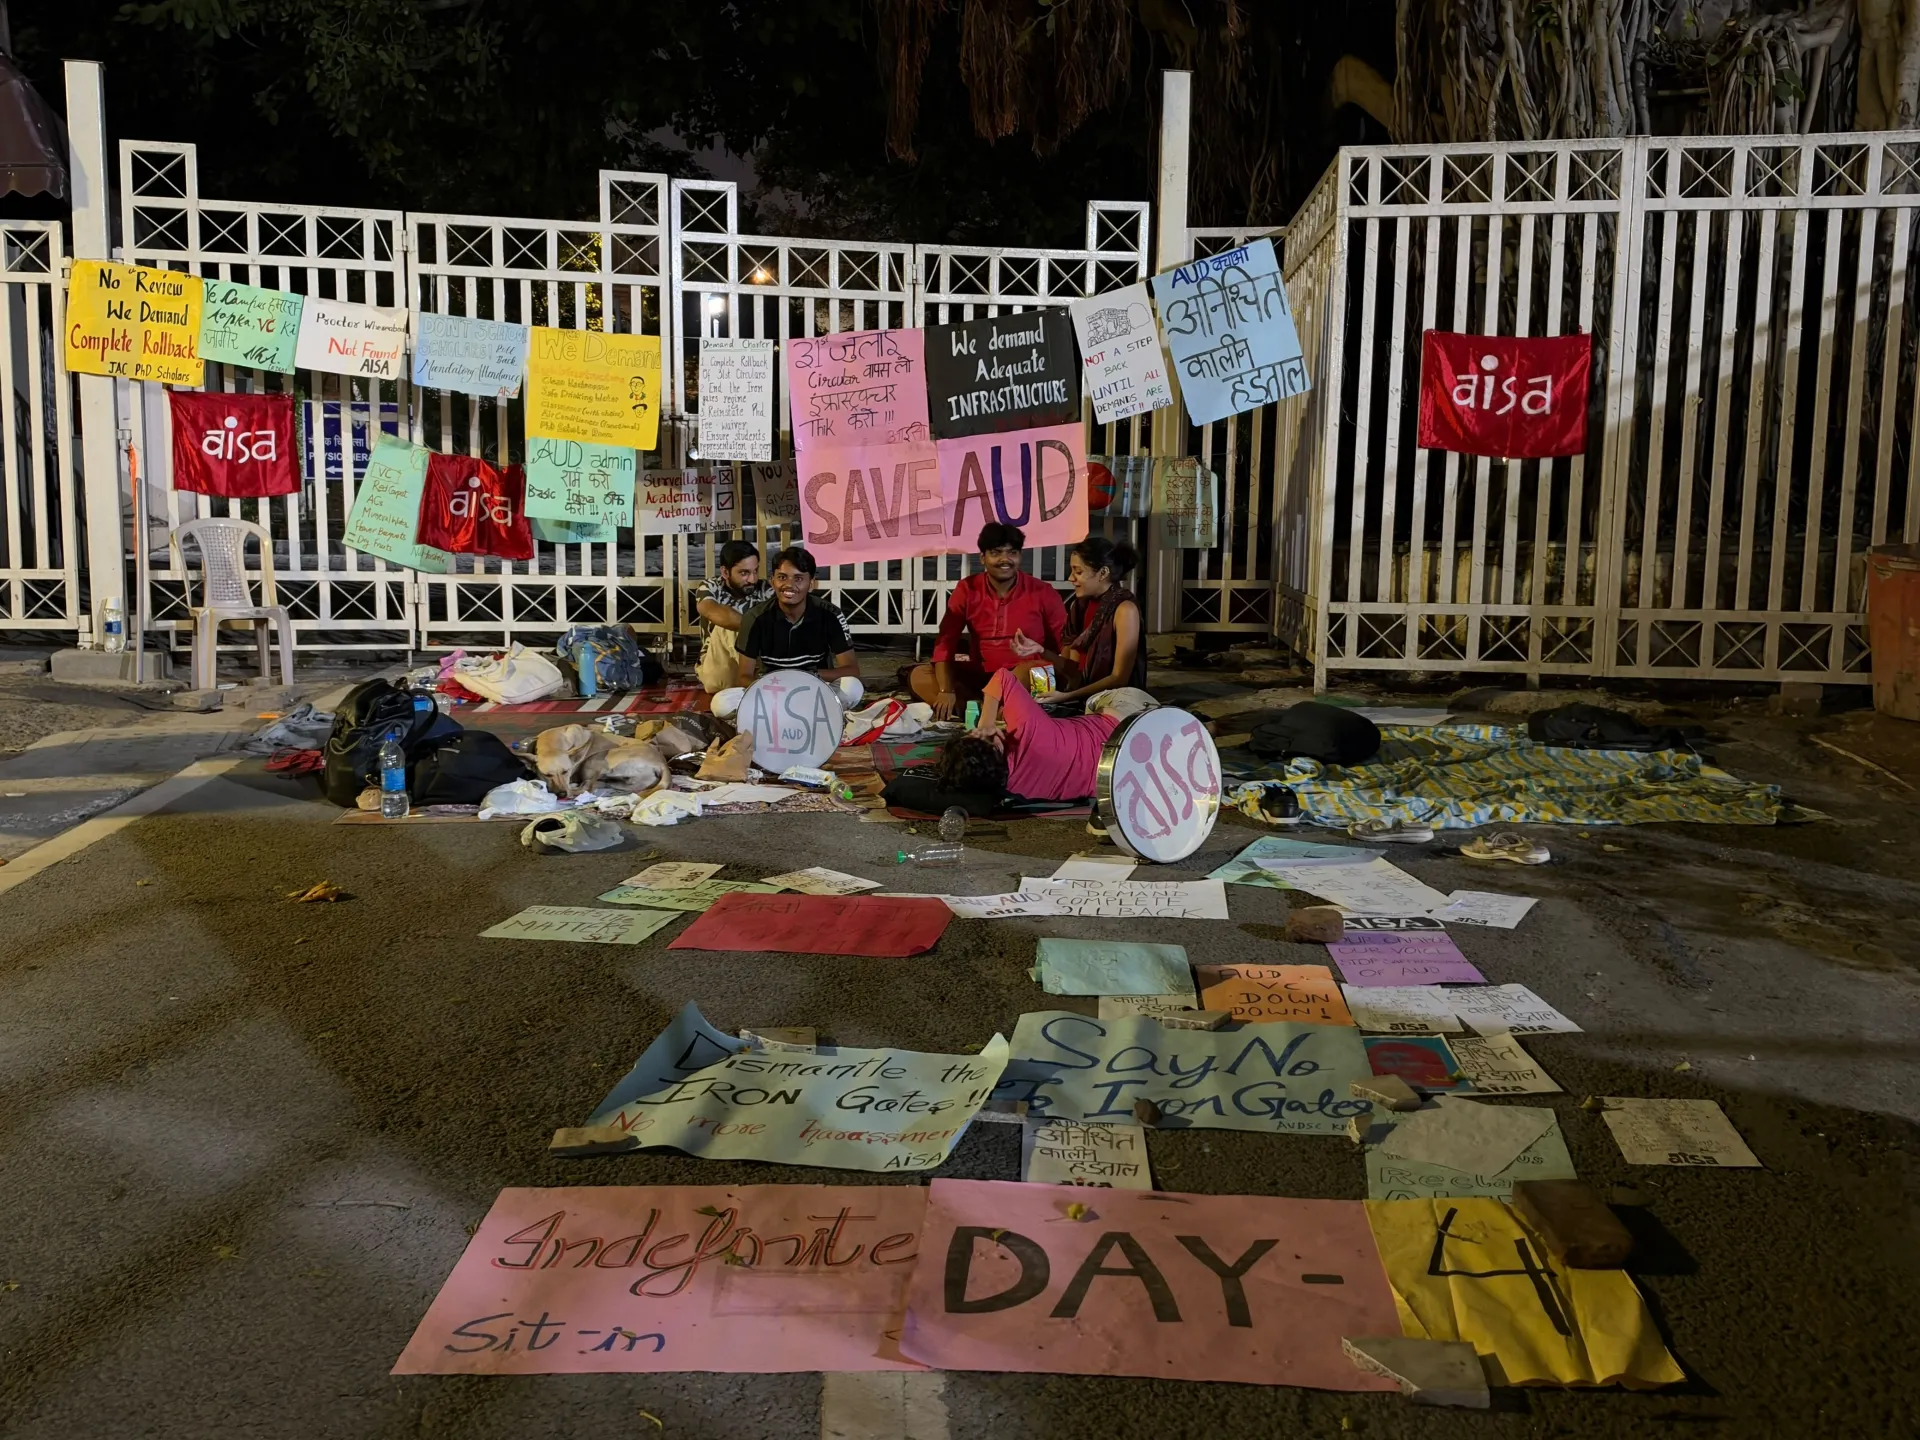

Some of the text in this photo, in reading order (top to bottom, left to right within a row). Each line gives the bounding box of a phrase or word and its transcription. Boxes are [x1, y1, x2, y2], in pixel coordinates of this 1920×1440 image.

[99, 268, 120, 289] No
[1171, 262, 1209, 288] AUD
[204, 282, 266, 313] Ye Campus
[106, 301, 188, 326] We Demand
[316, 312, 360, 328] Proctor
[257, 318, 276, 333] VC
[70, 324, 195, 361] Complete Rollback
[703, 340, 770, 349] Demand Charter
[952, 317, 1045, 356] We demand
[328, 336, 399, 359] Not Found
[538, 330, 577, 361] We
[1084, 351, 1105, 368] NOT
[1113, 348, 1121, 357] A
[1127, 336, 1152, 353] STEP
[360, 359, 389, 375] AISA
[496, 356, 517, 366] Back
[711, 356, 768, 369] Complete Rollback
[975, 349, 1045, 388] Adequate
[108, 362, 190, 382] JAC PhD Scholars
[417, 359, 475, 383] Mandatory
[478, 364, 521, 383] Attendance
[808, 368, 860, 388] Circular
[1104, 362, 1128, 378] BACK
[497, 386, 519, 397] AISA
[709, 382, 763, 393] End the Iron
[1092, 369, 1160, 401] UNTIL ALL
[1452, 355, 1552, 415] aisa
[560, 390, 593, 402] Drinking
[595, 393, 619, 403] Water
[723, 394, 746, 408] regime
[948, 379, 1068, 420] INFRASTRUCTURE
[1097, 385, 1163, 414] DEMANDS ARE
[709, 406, 744, 417] Reinstate
[1115, 406, 1137, 417] MET
[702, 419, 712, 429] Fee
[799, 418, 835, 436] Thik
[202, 416, 277, 463] aisa
[706, 431, 729, 441] Ensure
[531, 439, 632, 471] AUD admin
[378, 468, 392, 479] VC
[644, 474, 717, 487] Surveillance
[757, 465, 782, 482] YOU
[373, 480, 387, 492] Red
[804, 439, 1075, 545] SAVE AUD
[449, 477, 513, 526] aisa
[646, 489, 703, 505] Academic
[766, 491, 795, 504] GIVE
[656, 505, 712, 519] Autonomy
[678, 524, 692, 533] JAC
[710, 522, 737, 531] Scholars
[752, 684, 838, 755] AISA
[781, 728, 804, 740] AUD
[1115, 720, 1218, 840] aisa
[1072, 880, 1103, 889] NO
[949, 892, 1043, 906] SAVE AUD
[1056, 896, 1182, 906] COMPLETE
[503, 920, 633, 934] MATTERS
[1343, 917, 1418, 929] AISA
[1219, 969, 1282, 980] AUD
[1359, 967, 1440, 977] OF AUD
[1257, 982, 1300, 991] VC
[1238, 992, 1330, 1004] DOWN
[1389, 1022, 1430, 1032] aisa
[675, 1030, 987, 1085] Dismantle the
[1029, 1017, 1335, 1088] Say No
[636, 1077, 803, 1106] IRON
[1084, 1080, 1227, 1118] Ion
[1230, 1081, 1374, 1118] Gates
[612, 1111, 654, 1132] No
[688, 1113, 767, 1136] more
[1668, 1152, 1719, 1166] aisa
[1380, 1167, 1514, 1189] Recla
[492, 1206, 919, 1298] Indefinite
[1427, 1207, 1572, 1337] 4
